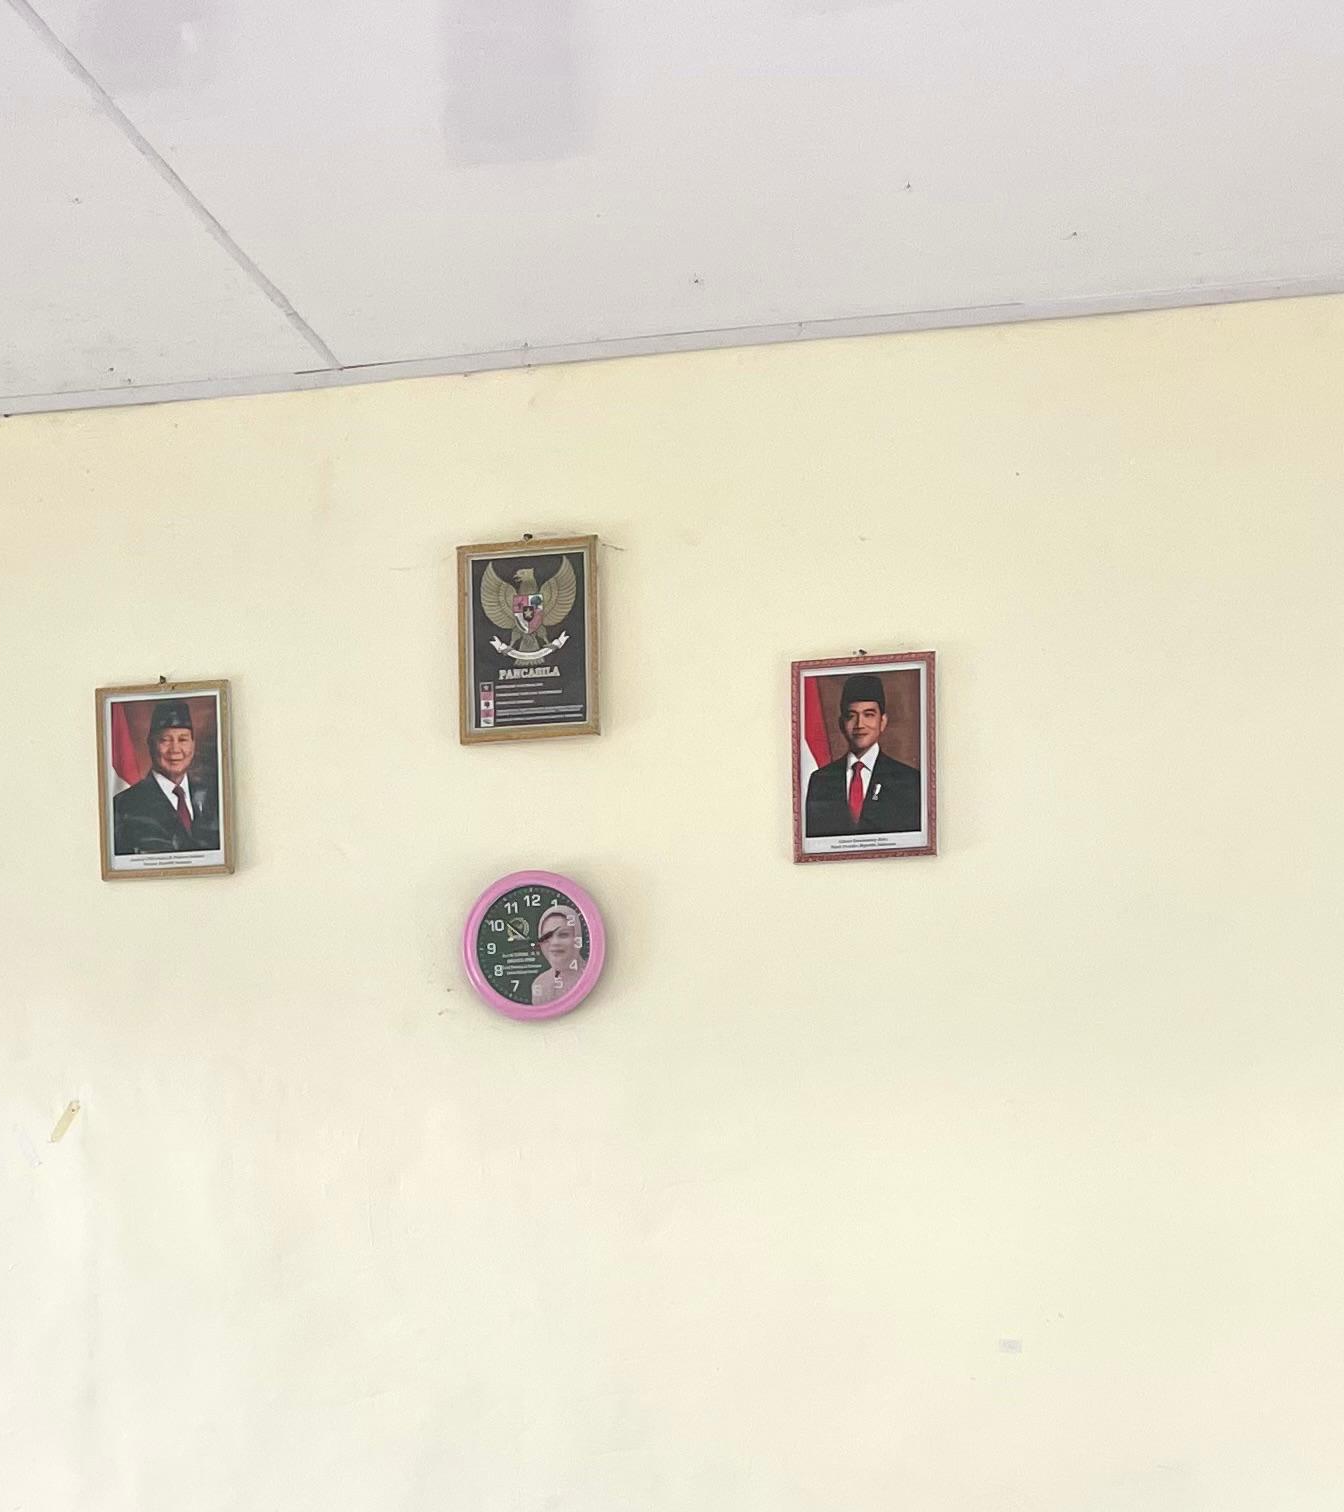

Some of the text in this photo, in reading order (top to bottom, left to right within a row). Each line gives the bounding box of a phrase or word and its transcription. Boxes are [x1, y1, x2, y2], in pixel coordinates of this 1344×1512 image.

[498, 666, 561, 680] PANCASILA
[523, 894, 541, 907] 12
[551, 899, 558, 908] 1
[504, 902, 519, 914] 11
[487, 919, 505, 932] 10
[566, 915, 576, 926] 2
[487, 943, 497, 954] 9
[574, 937, 583, 949] 3
[494, 965, 503, 977] 8
[569, 960, 578, 971] 4
[511, 980, 520, 992] 7
[554, 977, 563, 989] 5
